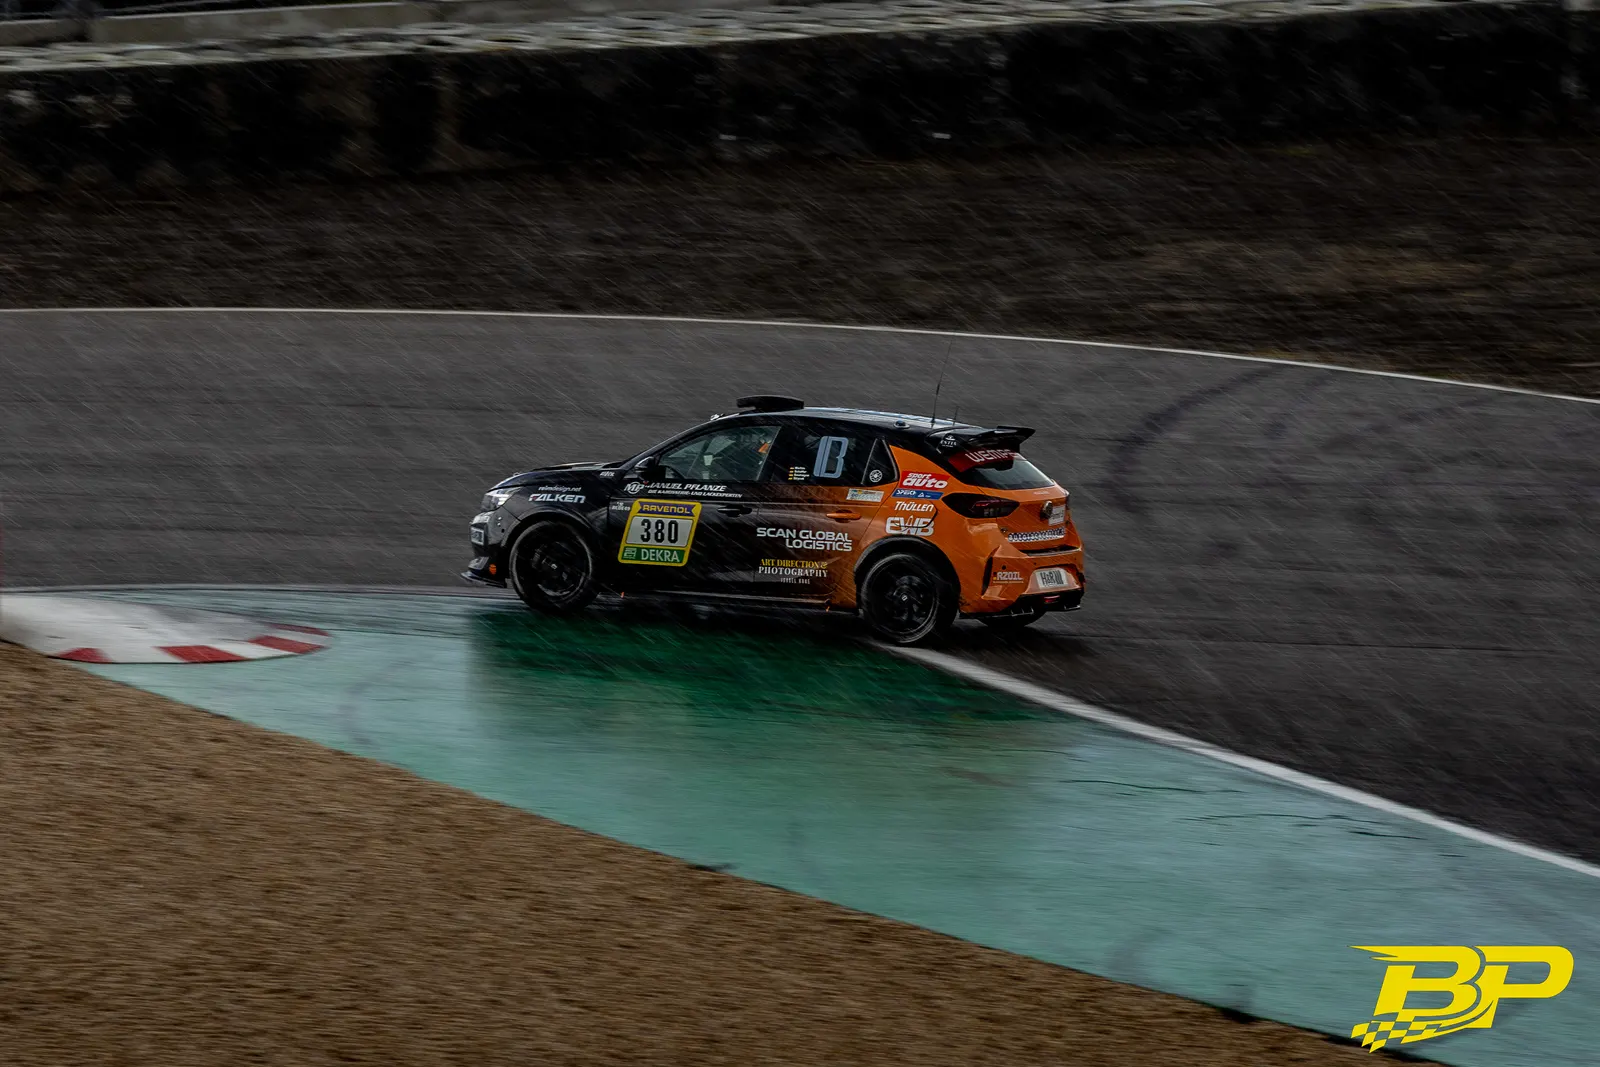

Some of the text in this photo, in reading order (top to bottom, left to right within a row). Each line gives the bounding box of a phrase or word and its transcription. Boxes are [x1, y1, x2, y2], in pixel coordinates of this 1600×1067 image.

[683, 483, 728, 492] PFLANZE
[902, 477, 949, 489] auto
[528, 493, 586, 504] FALKEN
[642, 503, 691, 514] RAVENOL
[640, 518, 679, 543] 380
[756, 527, 853, 542] SCAN GLOBAL
[785, 538, 853, 552] LOGISTICS
[640, 548, 681, 563] DEKRA
[759, 558, 775, 567] ART
[776, 559, 819, 569] DIRECTION
[758, 566, 828, 578] PHOTOGRAPHY
